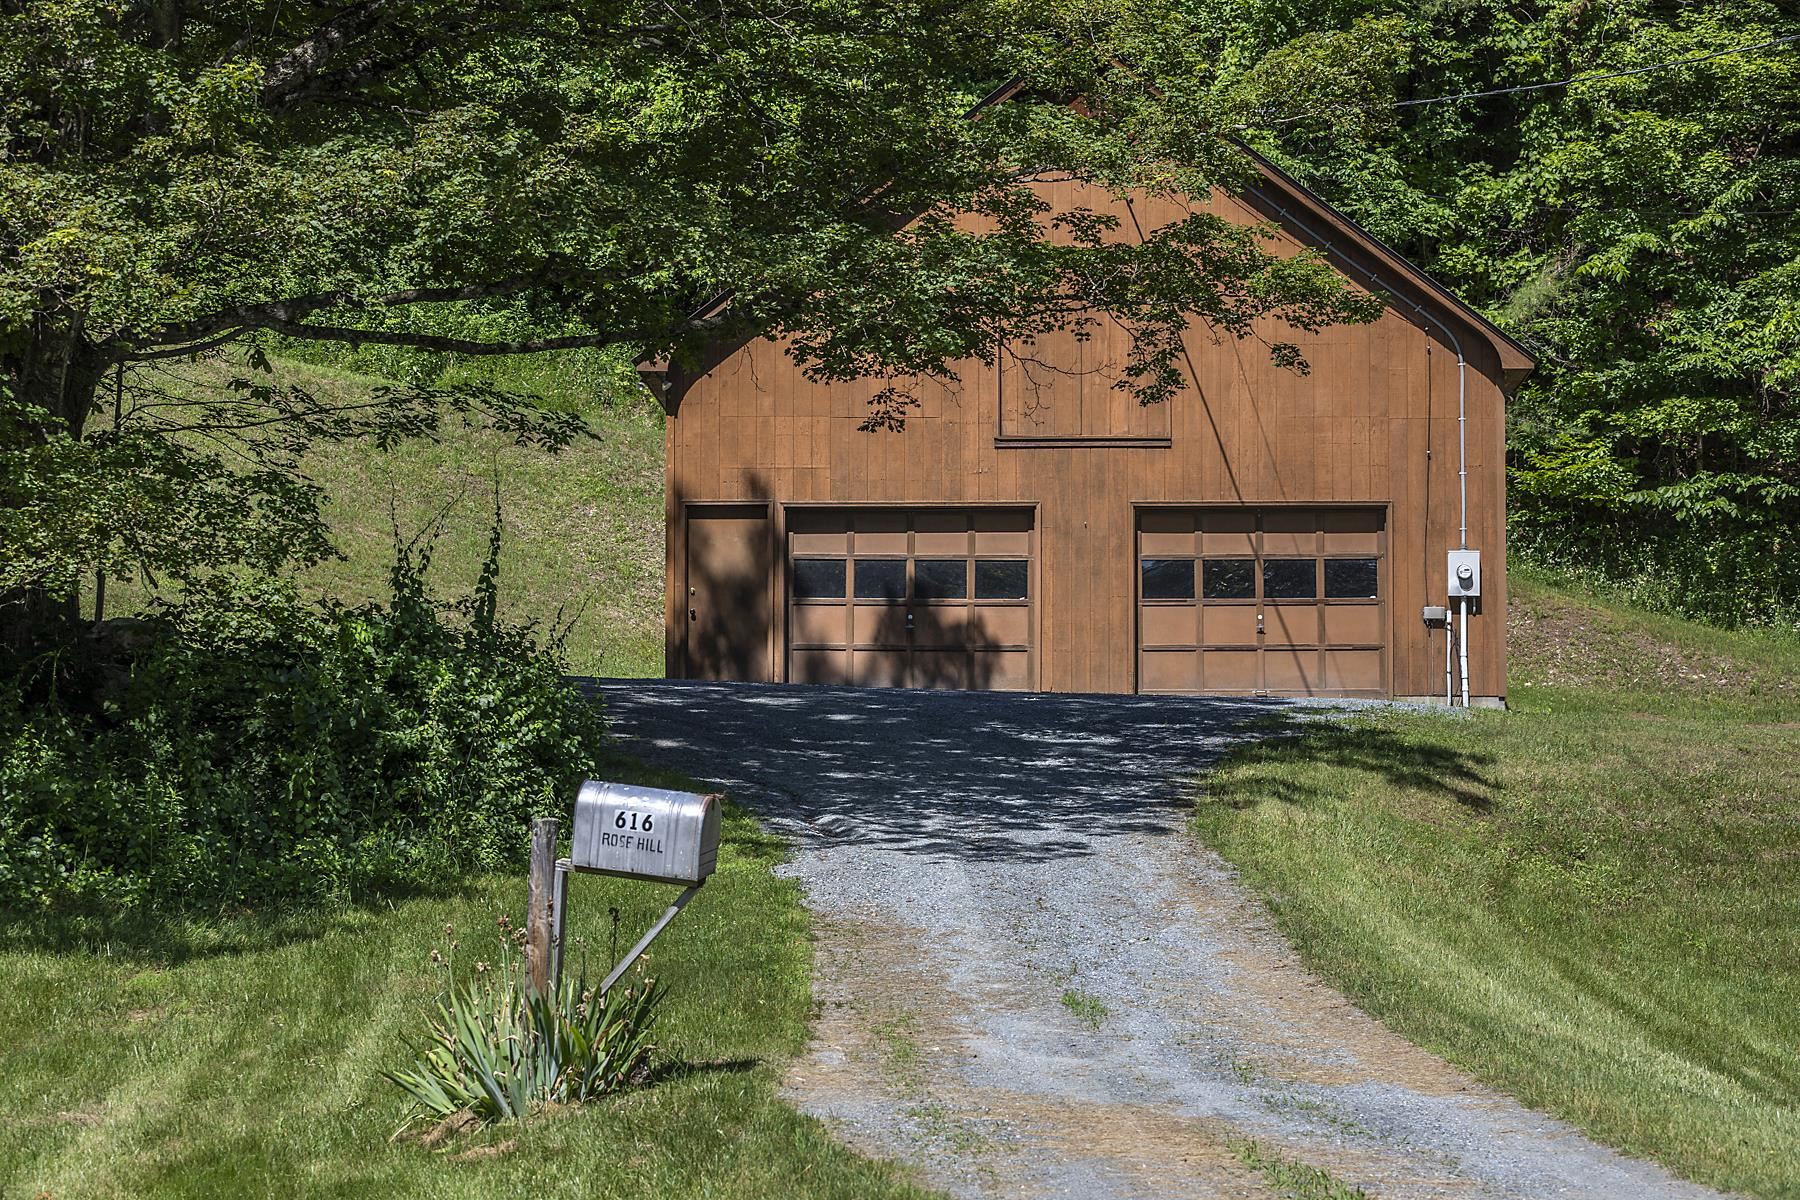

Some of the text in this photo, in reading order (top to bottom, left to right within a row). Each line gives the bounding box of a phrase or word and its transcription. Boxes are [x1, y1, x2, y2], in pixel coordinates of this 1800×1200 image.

[615, 811, 653, 832] 616
[602, 832, 663, 854] ROSE HILL
